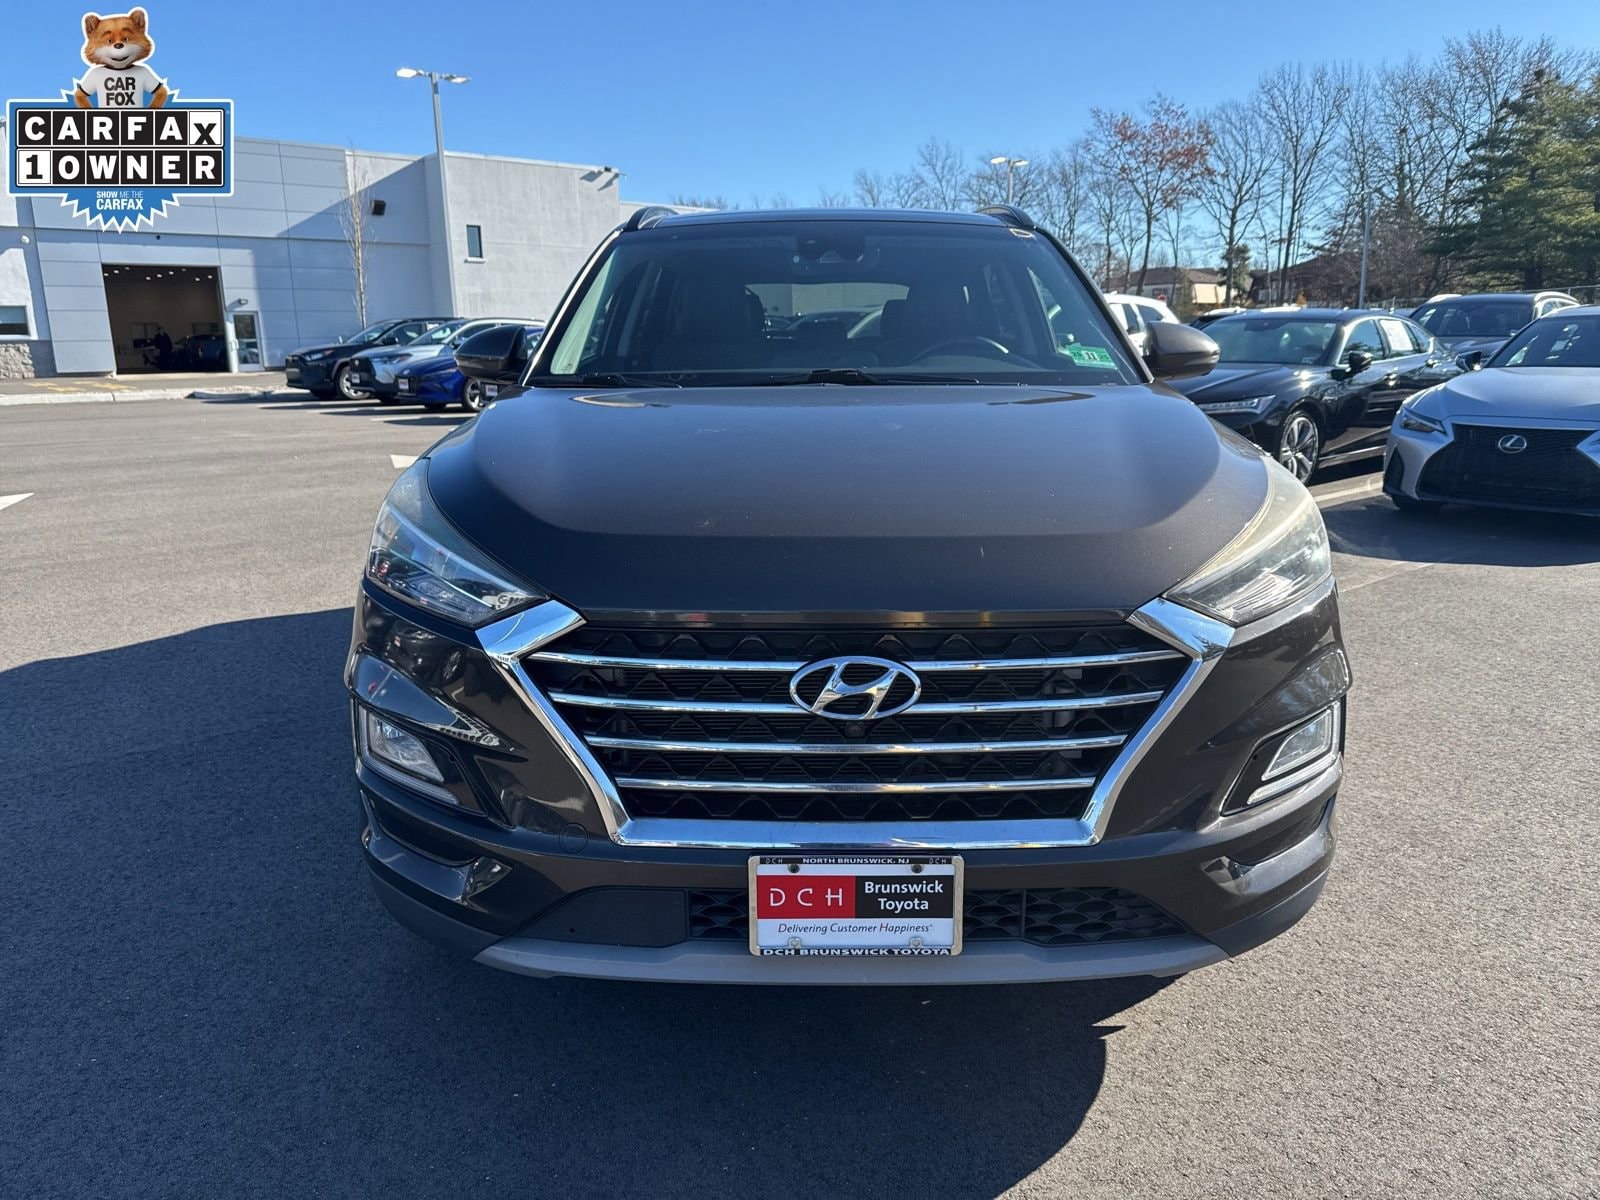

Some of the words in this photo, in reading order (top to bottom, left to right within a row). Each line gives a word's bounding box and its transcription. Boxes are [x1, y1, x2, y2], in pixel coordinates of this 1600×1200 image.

[864, 880, 944, 894] Brunswick
[877, 898, 929, 914] Toyota
[778, 923, 827, 935] Delivering
[830, 923, 877, 933] Customer
